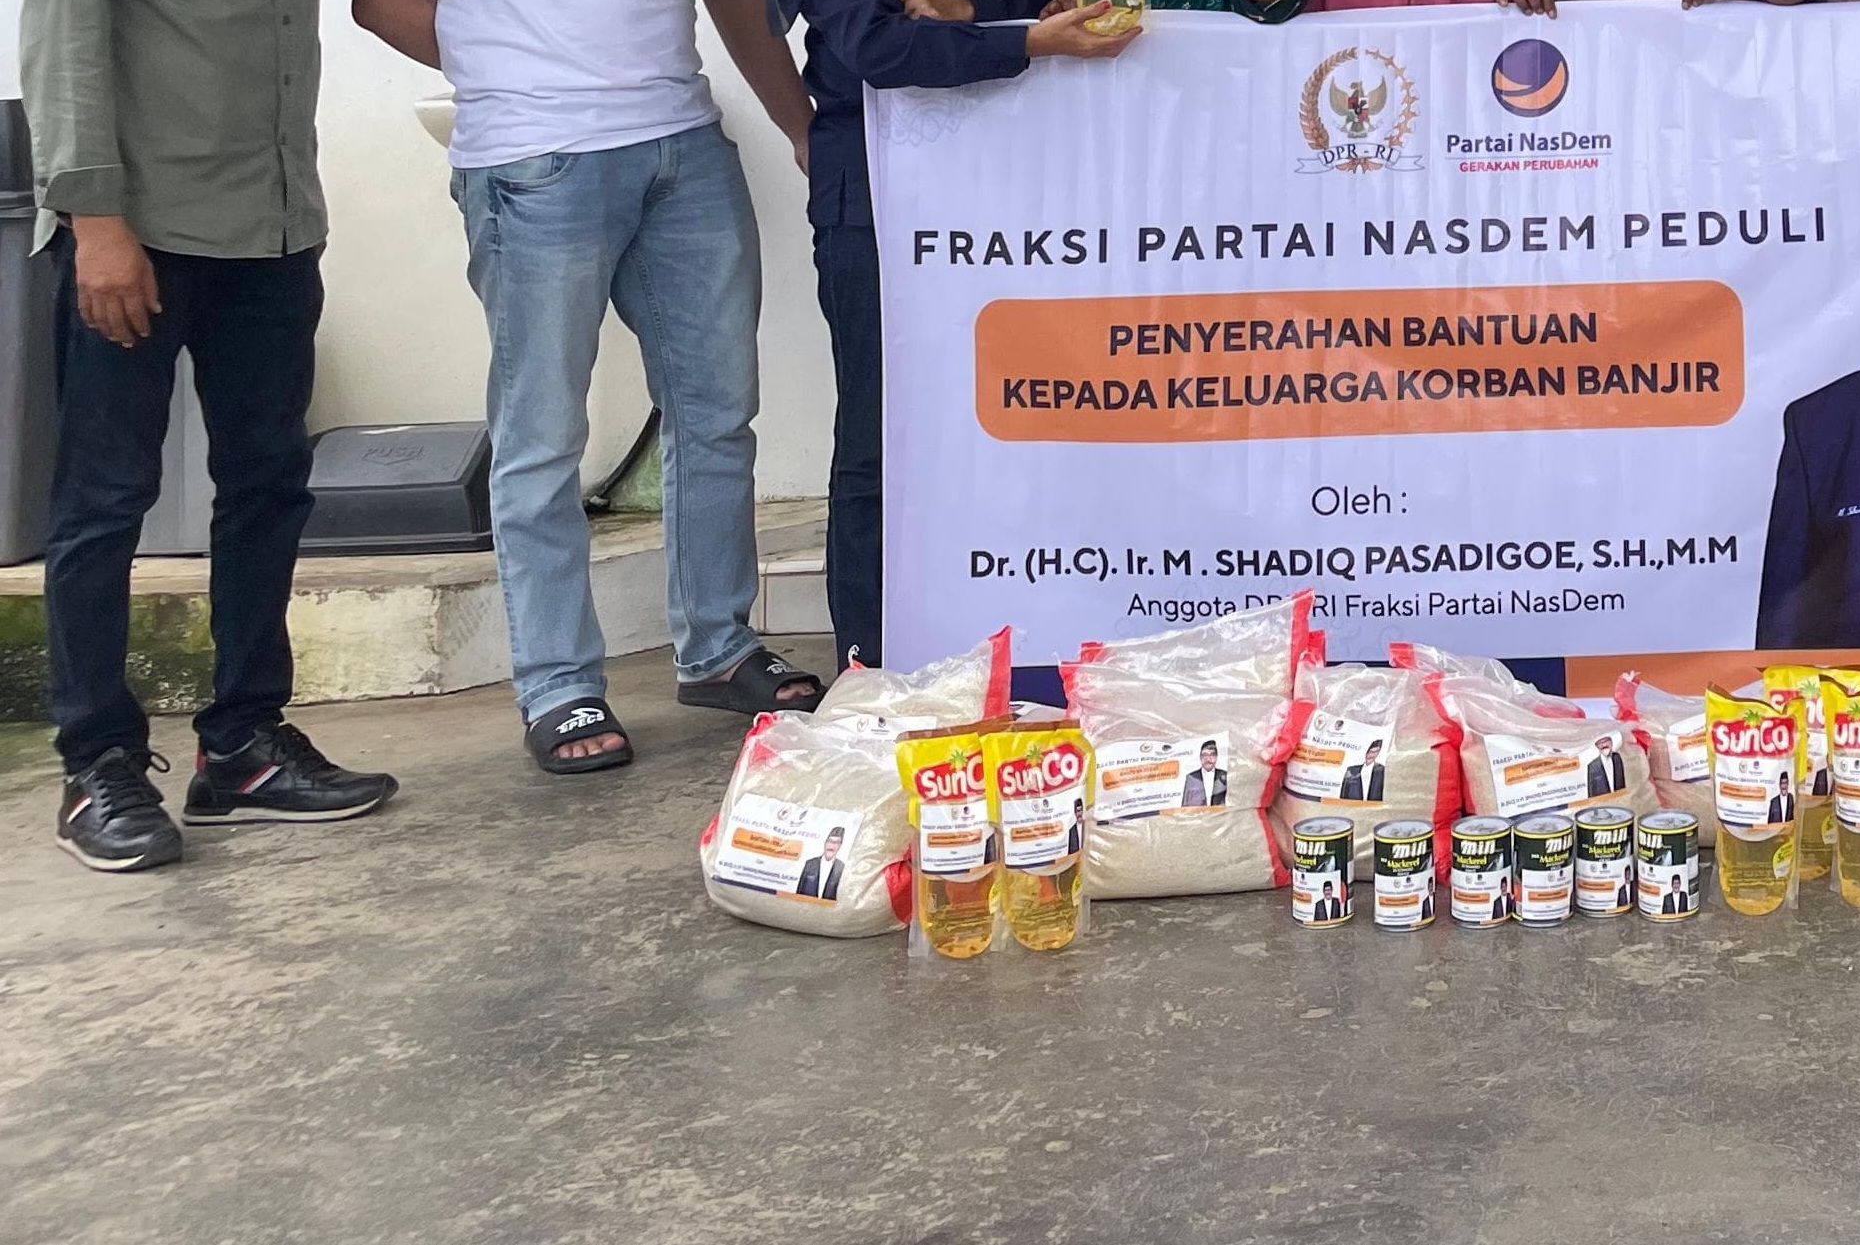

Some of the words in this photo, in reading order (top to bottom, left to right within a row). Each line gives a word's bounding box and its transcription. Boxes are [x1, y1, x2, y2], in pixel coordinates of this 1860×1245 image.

[1322, 143, 1357, 164] DPR
[1375, 144, 1394, 162] RI
[1447, 133, 1513, 153] Partai
[1520, 131, 1611, 151] NasDem
[1460, 161, 1519, 172] GERAKAN
[1523, 158, 1598, 170] PERUBAHAN
[913, 228, 1109, 265] FRAKSI
[1138, 222, 1334, 262] PARTAI
[1364, 215, 1595, 256] NASDEM
[1625, 207, 1825, 249] PEDULI
[1110, 317, 1391, 356] PENYERAHAN
[1404, 313, 1597, 347] BANTUAN
[1003, 378, 1158, 411] KEPADA
[1168, 372, 1388, 408] KELUARGA
[1398, 366, 1565, 401] KORBAN
[1578, 361, 1720, 395] BANJIR
[1311, 484, 1391, 516] Oleh
[970, 551, 1015, 578] Dr.
[1025, 547, 1118, 584] (H.C).
[1127, 548, 1154, 575] Ir.
[1216, 548, 1356, 582] SHADIQ
[1365, 540, 1584, 575] PASADIGOE,
[1592, 535, 1738, 571] S.H.,M.M
[1127, 593, 1236, 622] Anggota
[1345, 593, 1420, 617] Fraksi
[1429, 590, 1503, 616] Partai
[1511, 588, 1625, 614] NasDem
[1717, 720, 1790, 753] SunCo
[921, 756, 983, 797] SunC
[1003, 752, 1079, 794] SunCo
